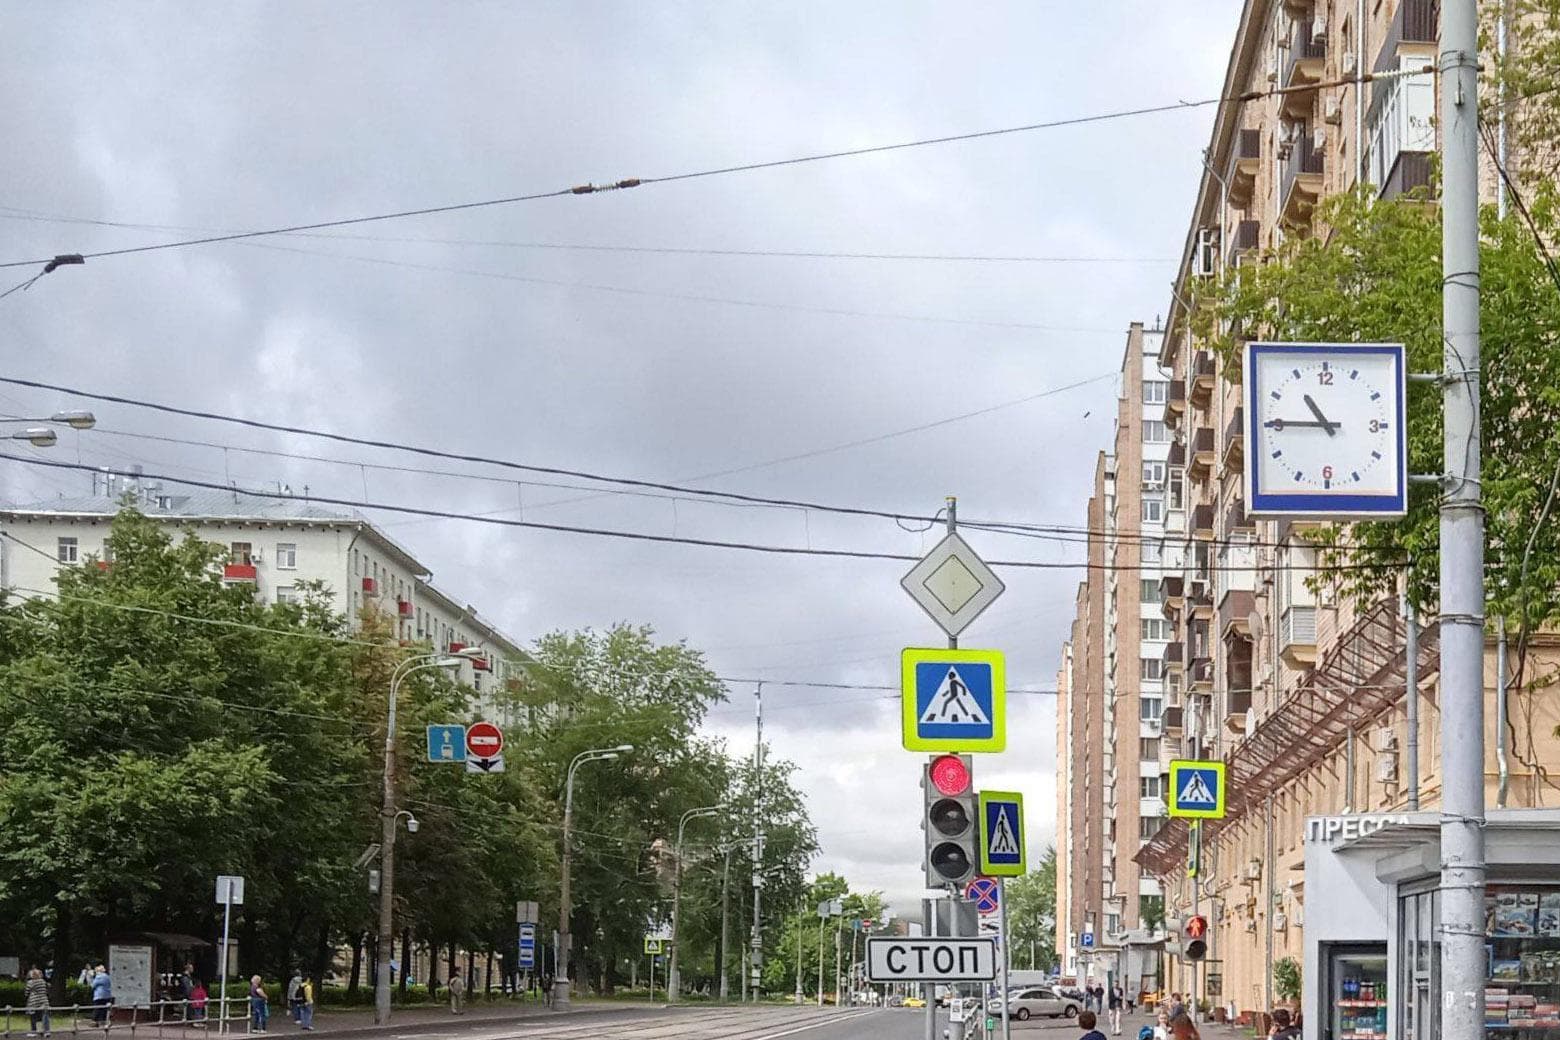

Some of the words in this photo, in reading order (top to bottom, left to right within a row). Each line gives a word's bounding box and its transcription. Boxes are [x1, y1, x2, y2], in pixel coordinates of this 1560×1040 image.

[1316, 371, 1334, 386] 12
[1368, 419, 1379, 433] 3
[1322, 465, 1333, 480] 6
[1083, 934, 1093, 945] P
[886, 945, 979, 974] СТОП
